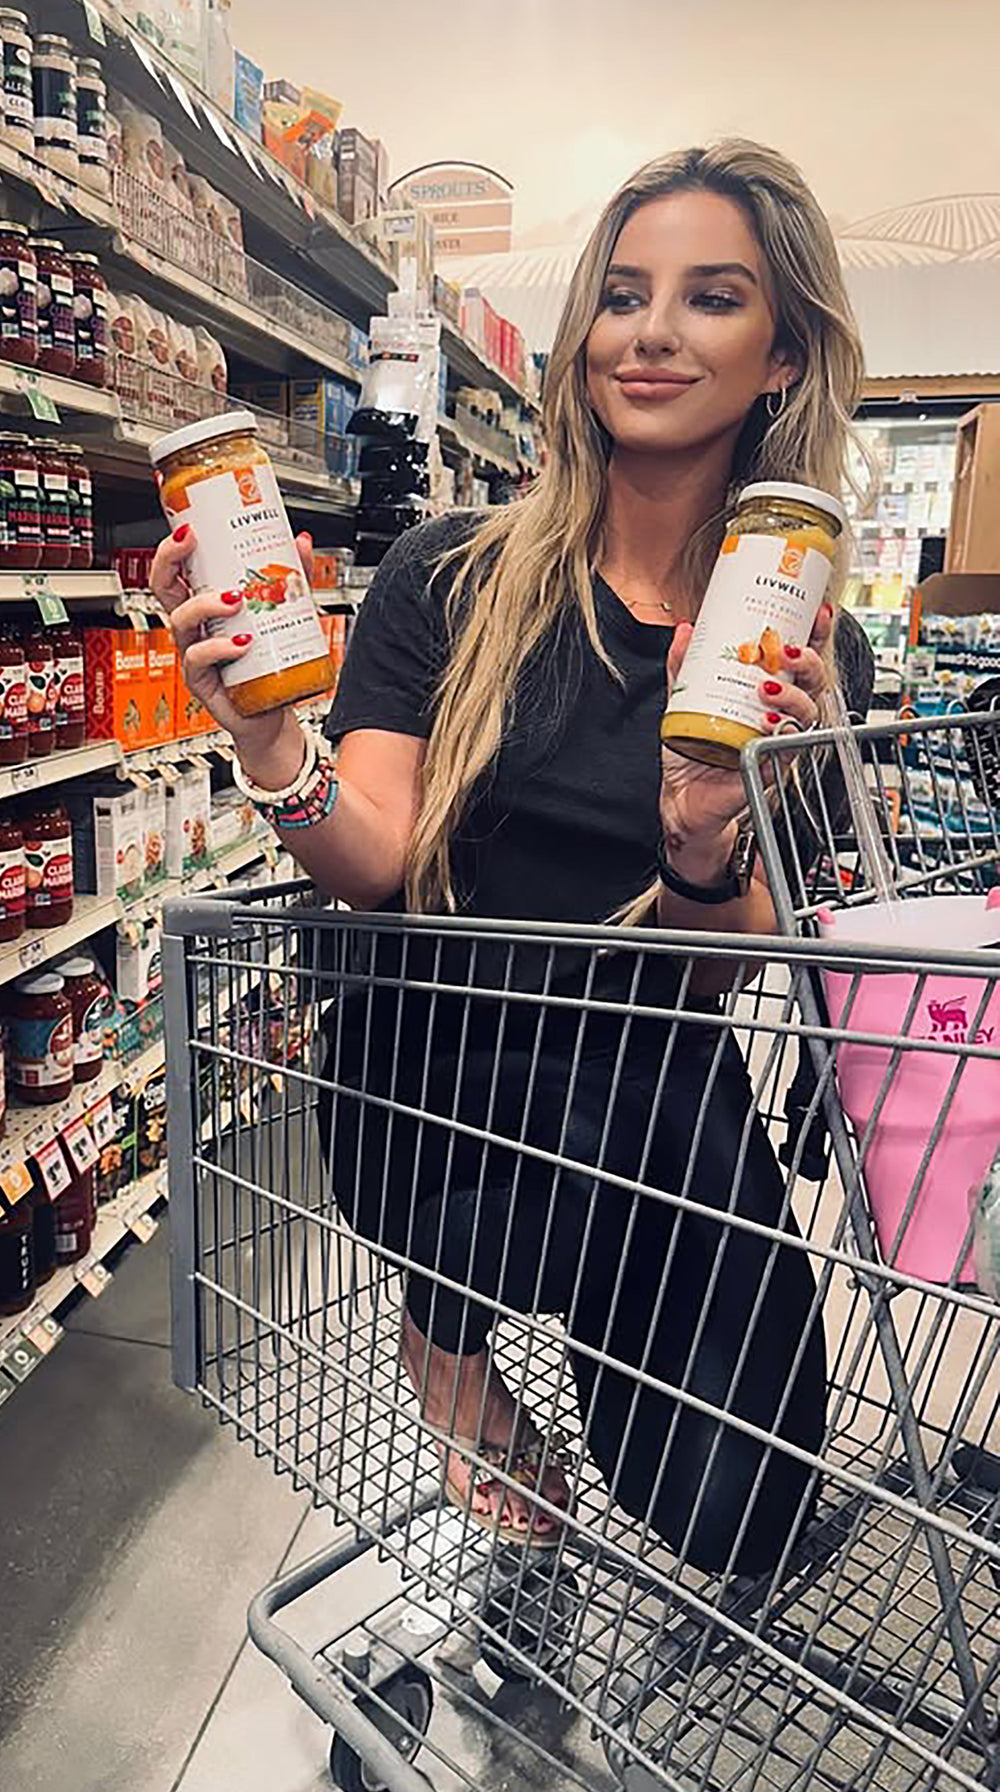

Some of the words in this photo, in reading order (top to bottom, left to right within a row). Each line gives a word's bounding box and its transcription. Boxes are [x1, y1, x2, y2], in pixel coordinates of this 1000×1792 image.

[410, 181, 487, 199] SPROUTS
[433, 213, 459, 223] RICE
[435, 239, 461, 249] ASTA
[230, 509, 279, 529] LIVWELL
[755, 575, 806, 602] LIVWELL
